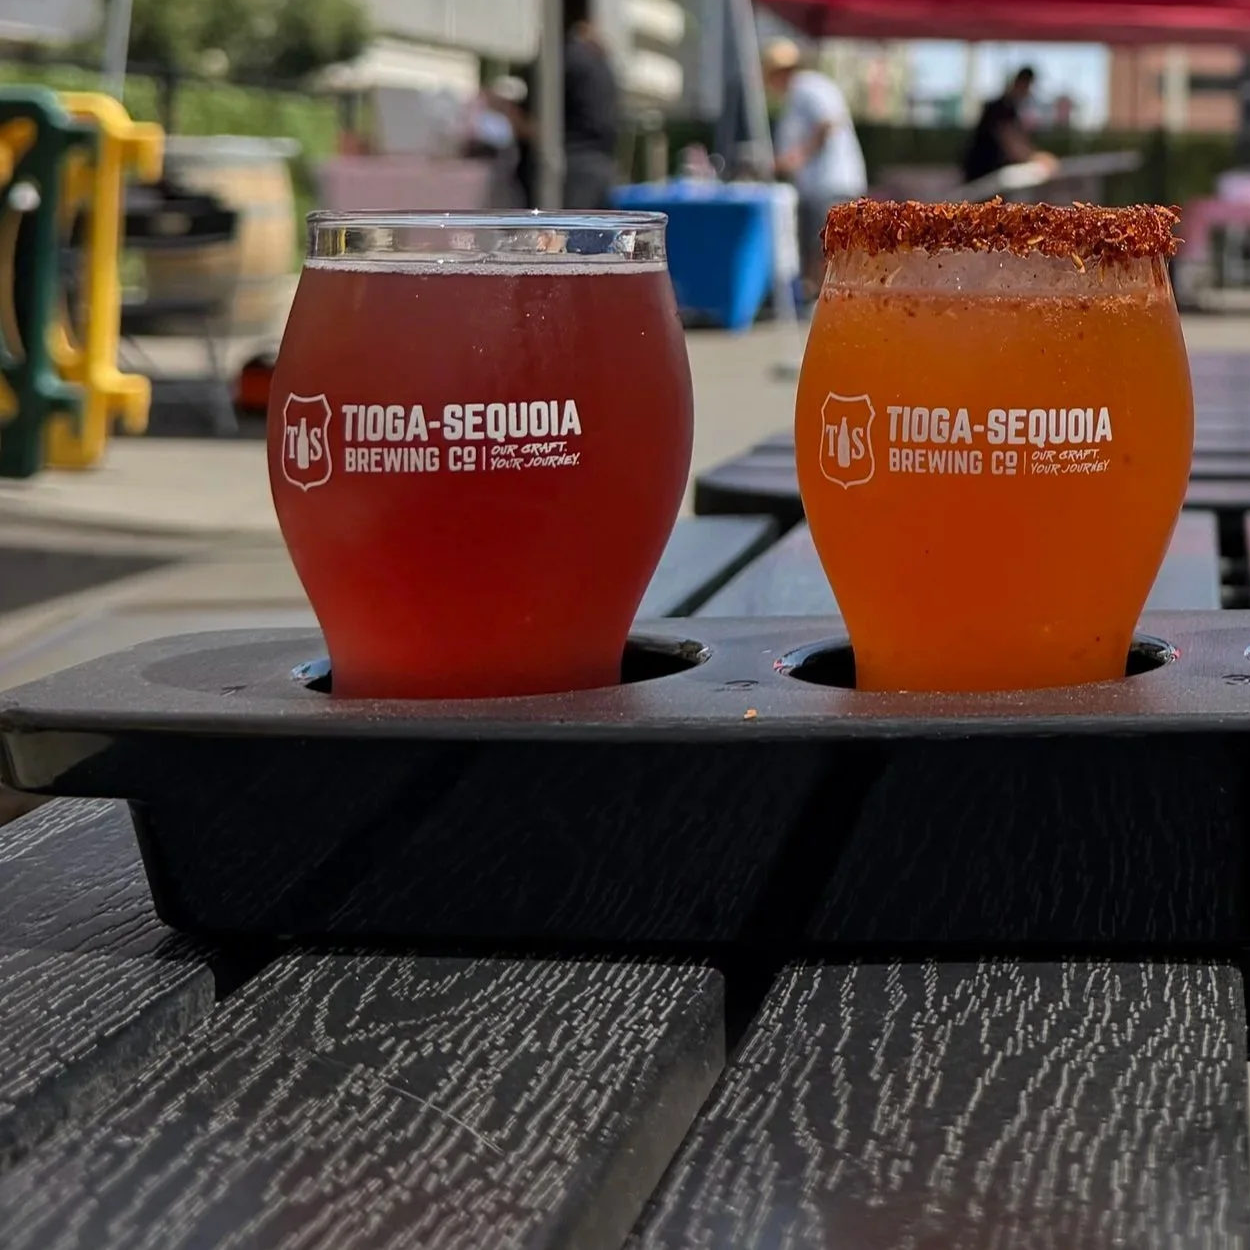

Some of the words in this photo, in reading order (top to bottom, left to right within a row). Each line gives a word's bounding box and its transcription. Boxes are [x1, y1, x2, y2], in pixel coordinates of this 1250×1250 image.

[342, 400, 582, 442] TIOGA-SEQUOIA
[887, 406, 1112, 448] TIOGA-SEQUOIA
[344, 447, 440, 473] BREWING
[491, 444, 518, 457] OUR
[491, 457, 524, 470] YOUR
[524, 452, 580, 468] JOURNEY.
[889, 448, 982, 475] BREWING
[1031, 451, 1056, 462] OUR
[1031, 462, 1060, 476] YOUR
